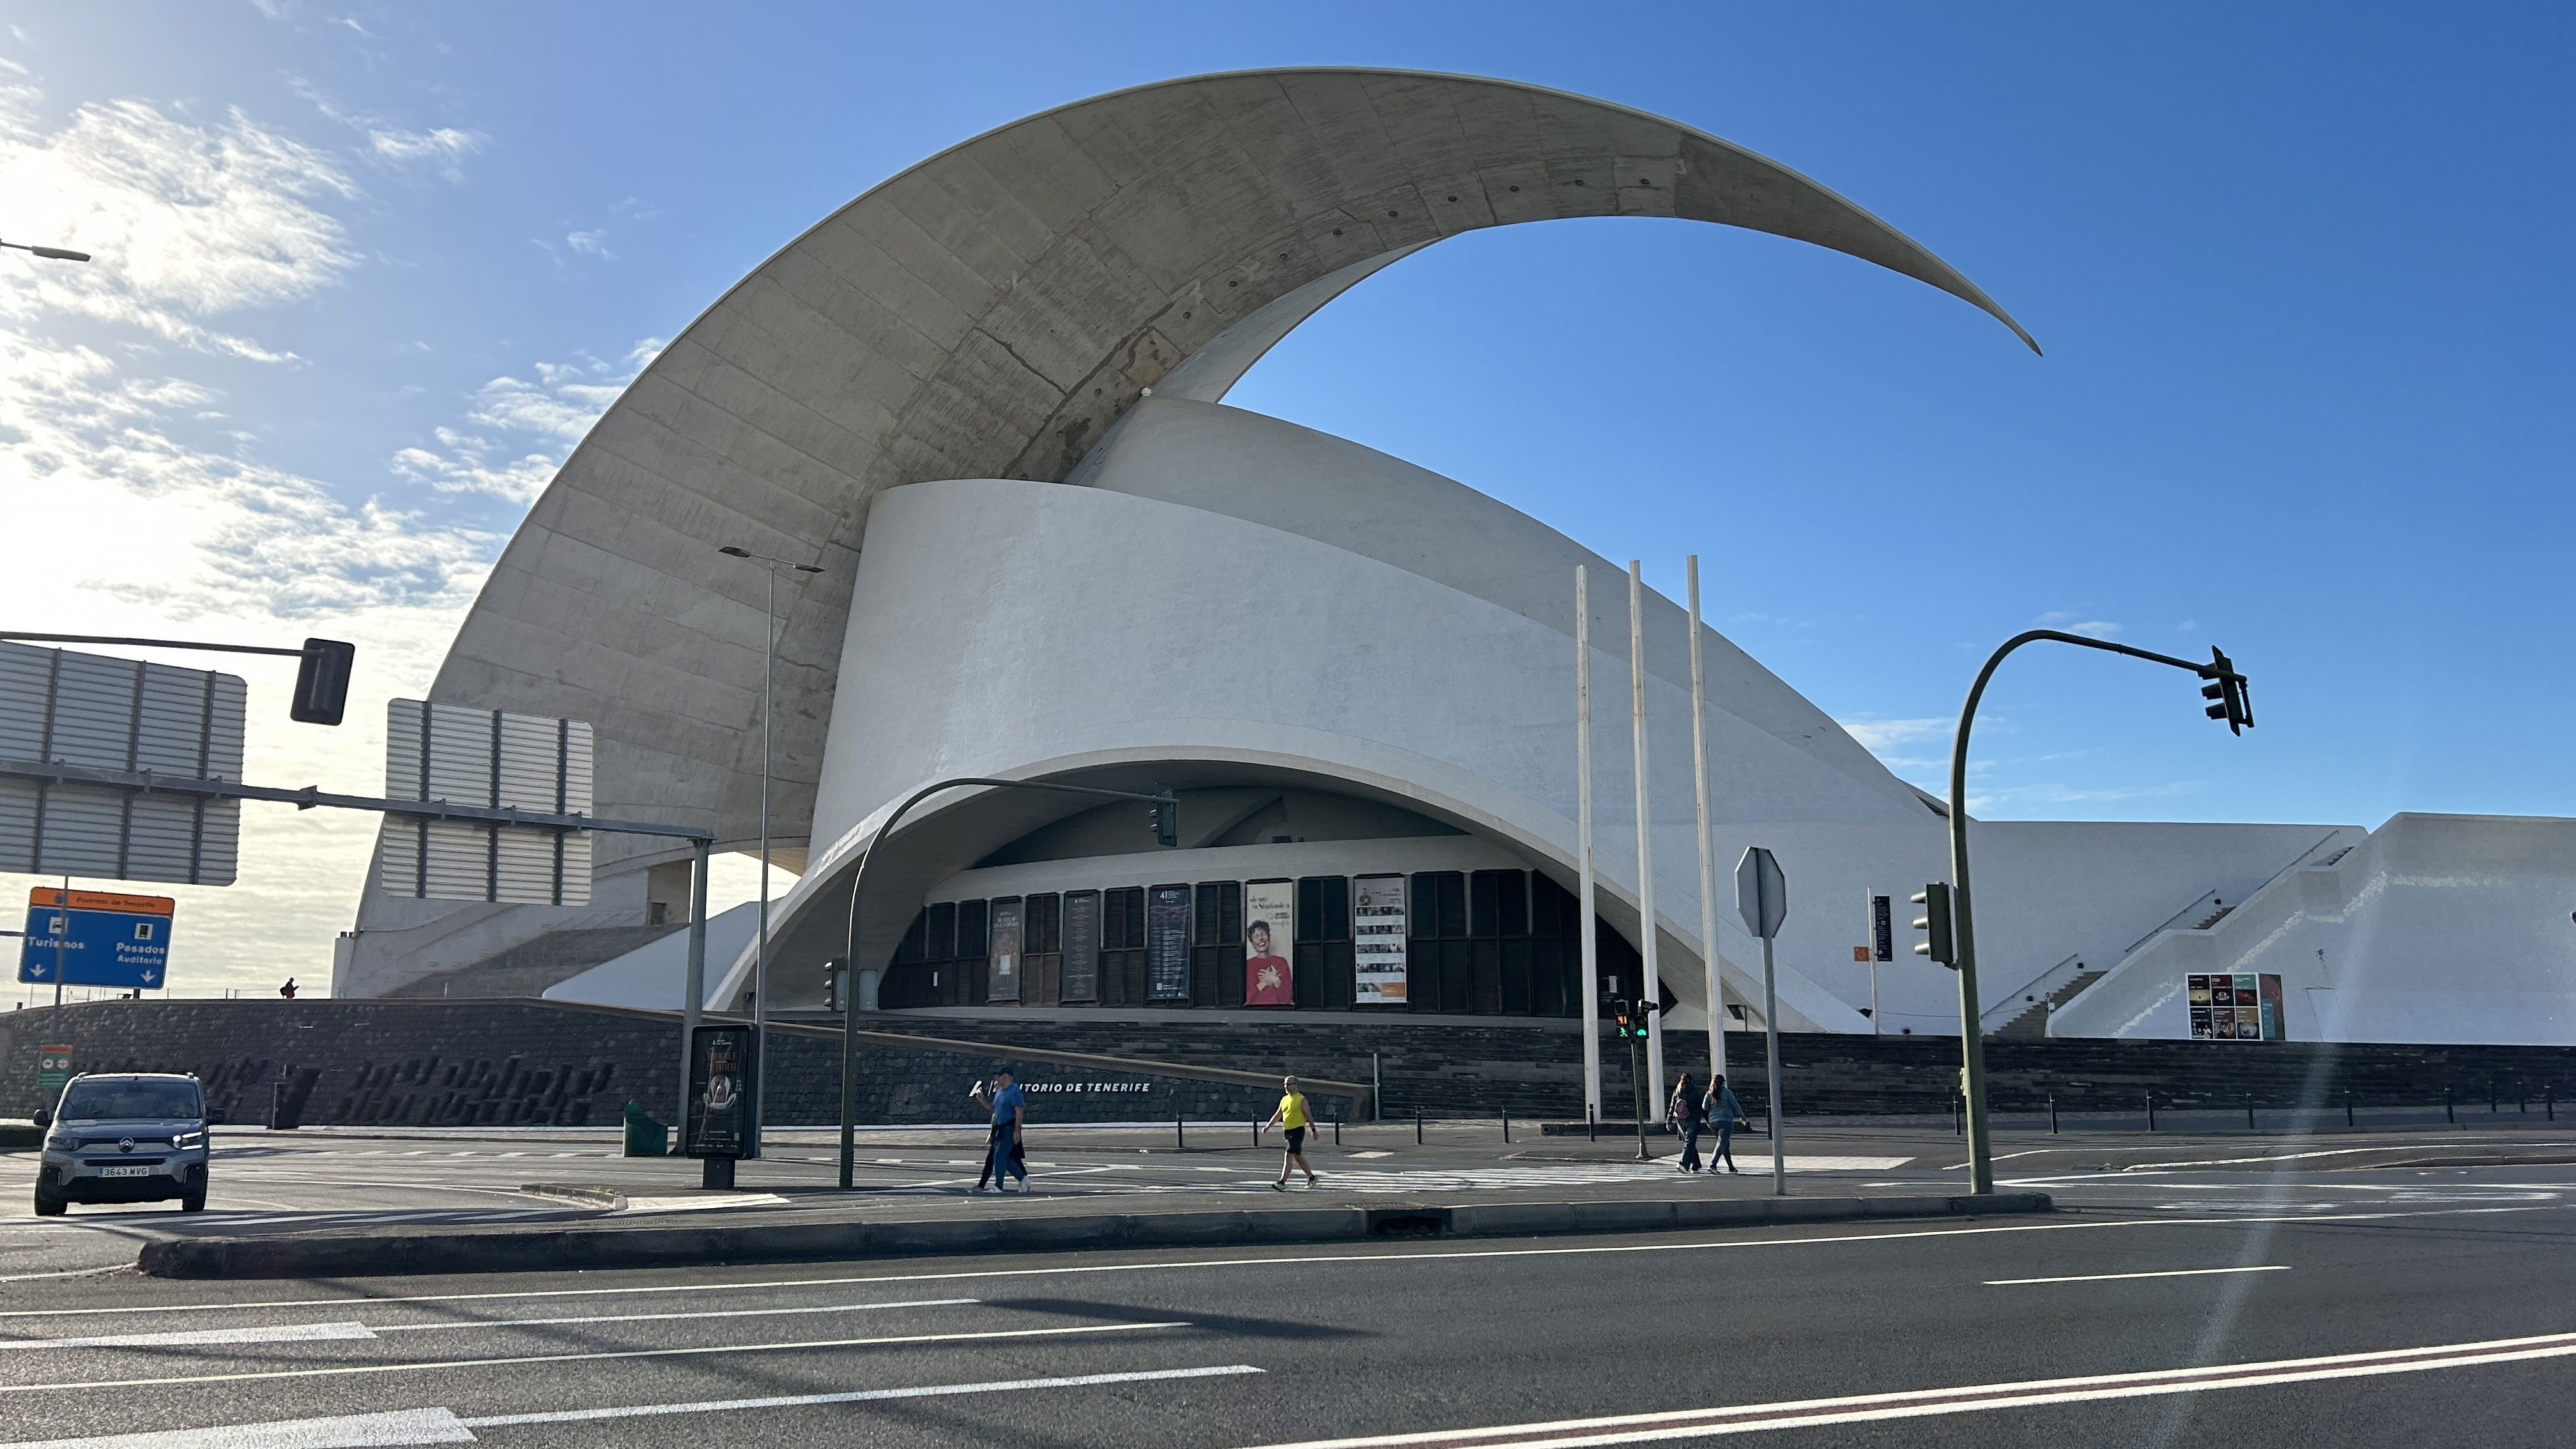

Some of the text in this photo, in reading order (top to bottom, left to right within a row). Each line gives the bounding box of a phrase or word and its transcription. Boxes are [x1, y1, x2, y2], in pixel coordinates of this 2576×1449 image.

[1160, 891, 1168, 900] 41
[116, 942, 165, 954] Pesados
[117, 954, 162, 965] Auditorio
[1618, 1016, 1627, 1024] 41
[1065, 1083, 1083, 1092] DE
[1087, 1082, 1151, 1092] TENERIFE
